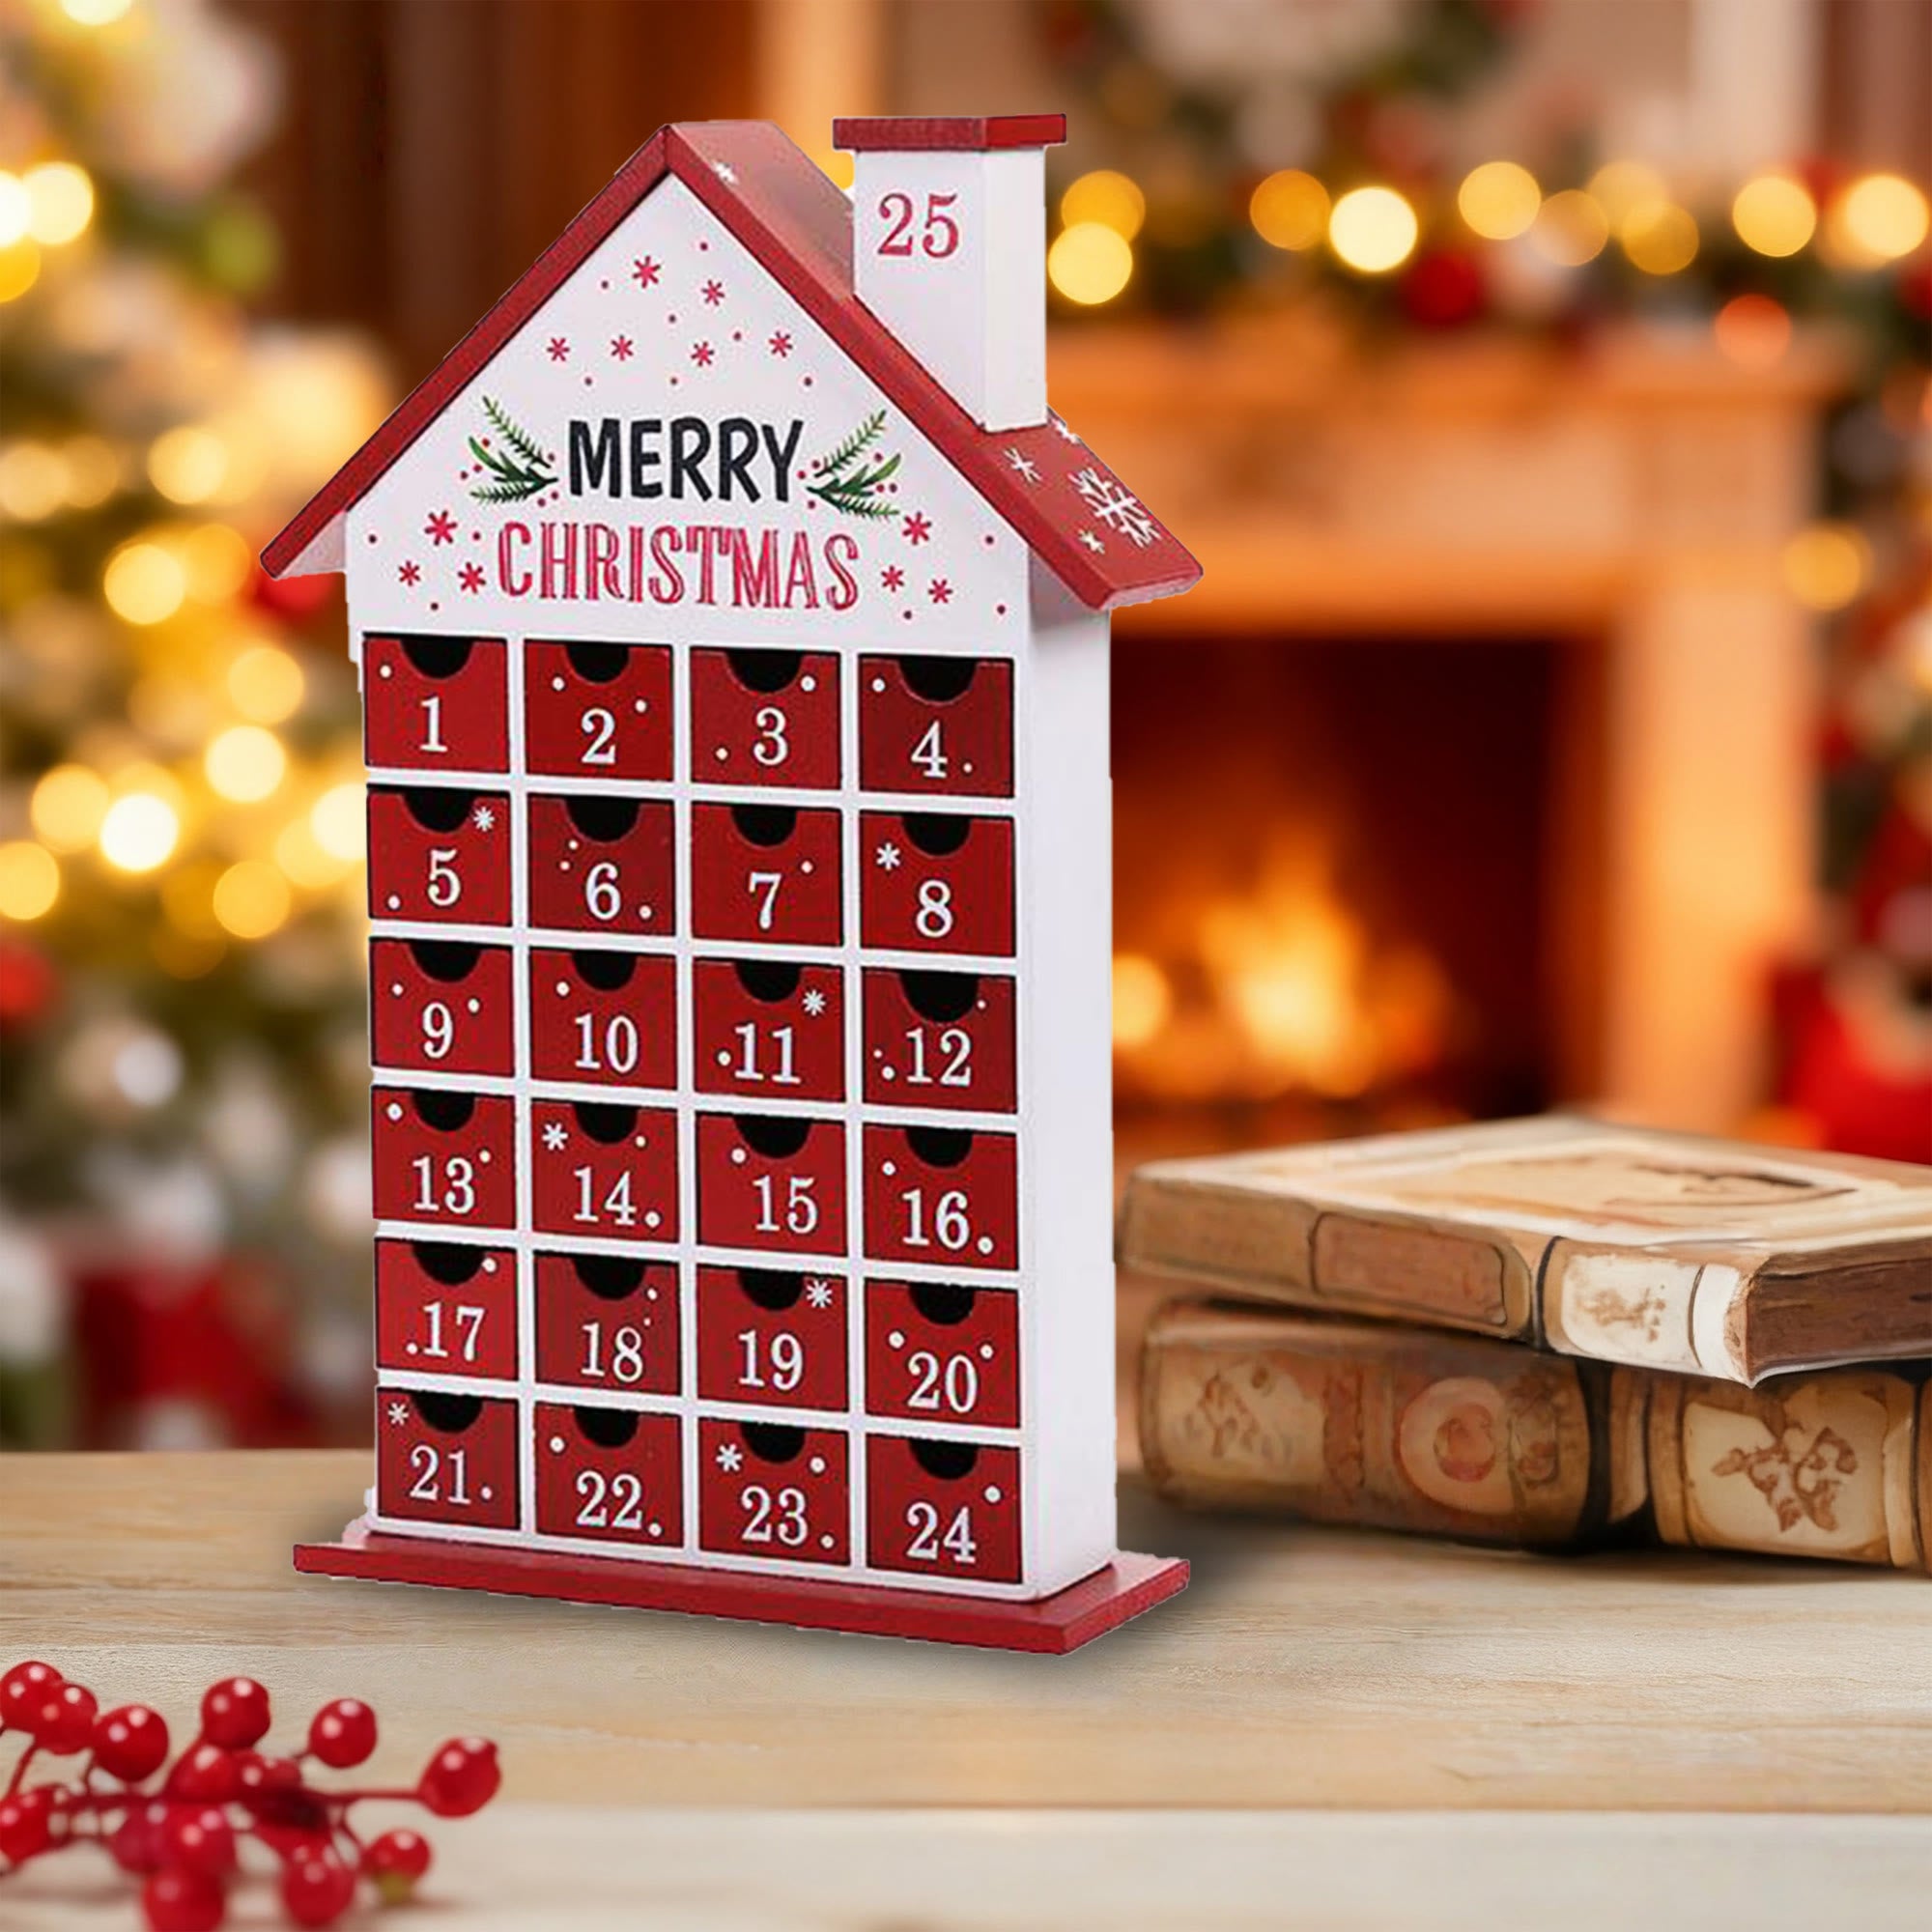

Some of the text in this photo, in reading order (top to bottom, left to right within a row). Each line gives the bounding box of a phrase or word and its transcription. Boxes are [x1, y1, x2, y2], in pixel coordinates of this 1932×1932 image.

[878, 193, 959, 258] 25
[569, 416, 805, 502] MERRY
[497, 522, 859, 610] CHRISTMAS
[419, 696, 448, 753] 1
[581, 708, 616, 764] 2
[753, 707, 788, 766] 3
[911, 721, 949, 779] 4
[427, 849, 461, 906] 5
[585, 862, 621, 921] 6
[749, 871, 781, 929] 7
[916, 879, 953, 938] 8
[422, 1002, 453, 1059] 9
[575, 1012, 639, 1073] 10
[734, 1023, 801, 1084] 11
[906, 1027, 972, 1087] 12
[412, 1155, 475, 1214] 13
[573, 1166, 638, 1226] 14
[753, 1175, 818, 1234] 15
[902, 1188, 970, 1250] 16
[423, 1301, 485, 1362] 17
[581, 1322, 643, 1382] 18
[738, 1329, 803, 1391] 19
[907, 1351, 978, 1413] 20
[409, 1444, 471, 1505] 21
[576, 1470, 642, 1530] 22
[741, 1486, 808, 1546] 23
[906, 1501, 977, 1564] 24
